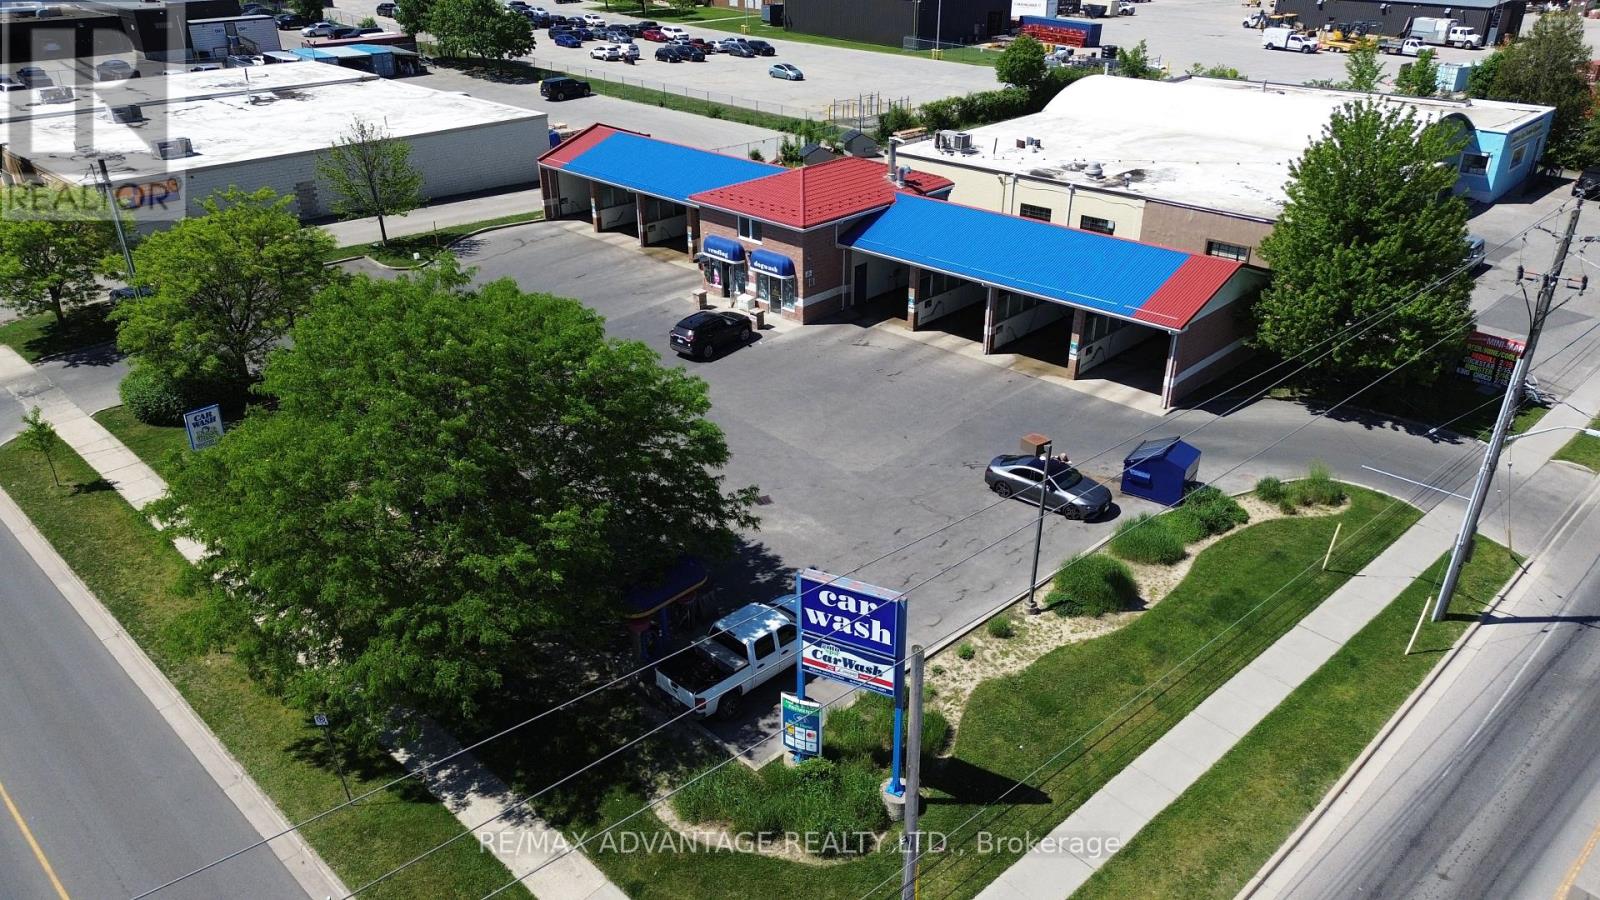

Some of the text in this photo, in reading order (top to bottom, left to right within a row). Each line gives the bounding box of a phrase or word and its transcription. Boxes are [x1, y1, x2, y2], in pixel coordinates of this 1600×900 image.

[754, 261, 778, 273] dogwash
[1487, 337, 1525, 353] MINI-MAR
[191, 416, 216, 428] WASH
[193, 411, 212, 422] CAR
[818, 590, 878, 617] car
[804, 607, 892, 646] wash
